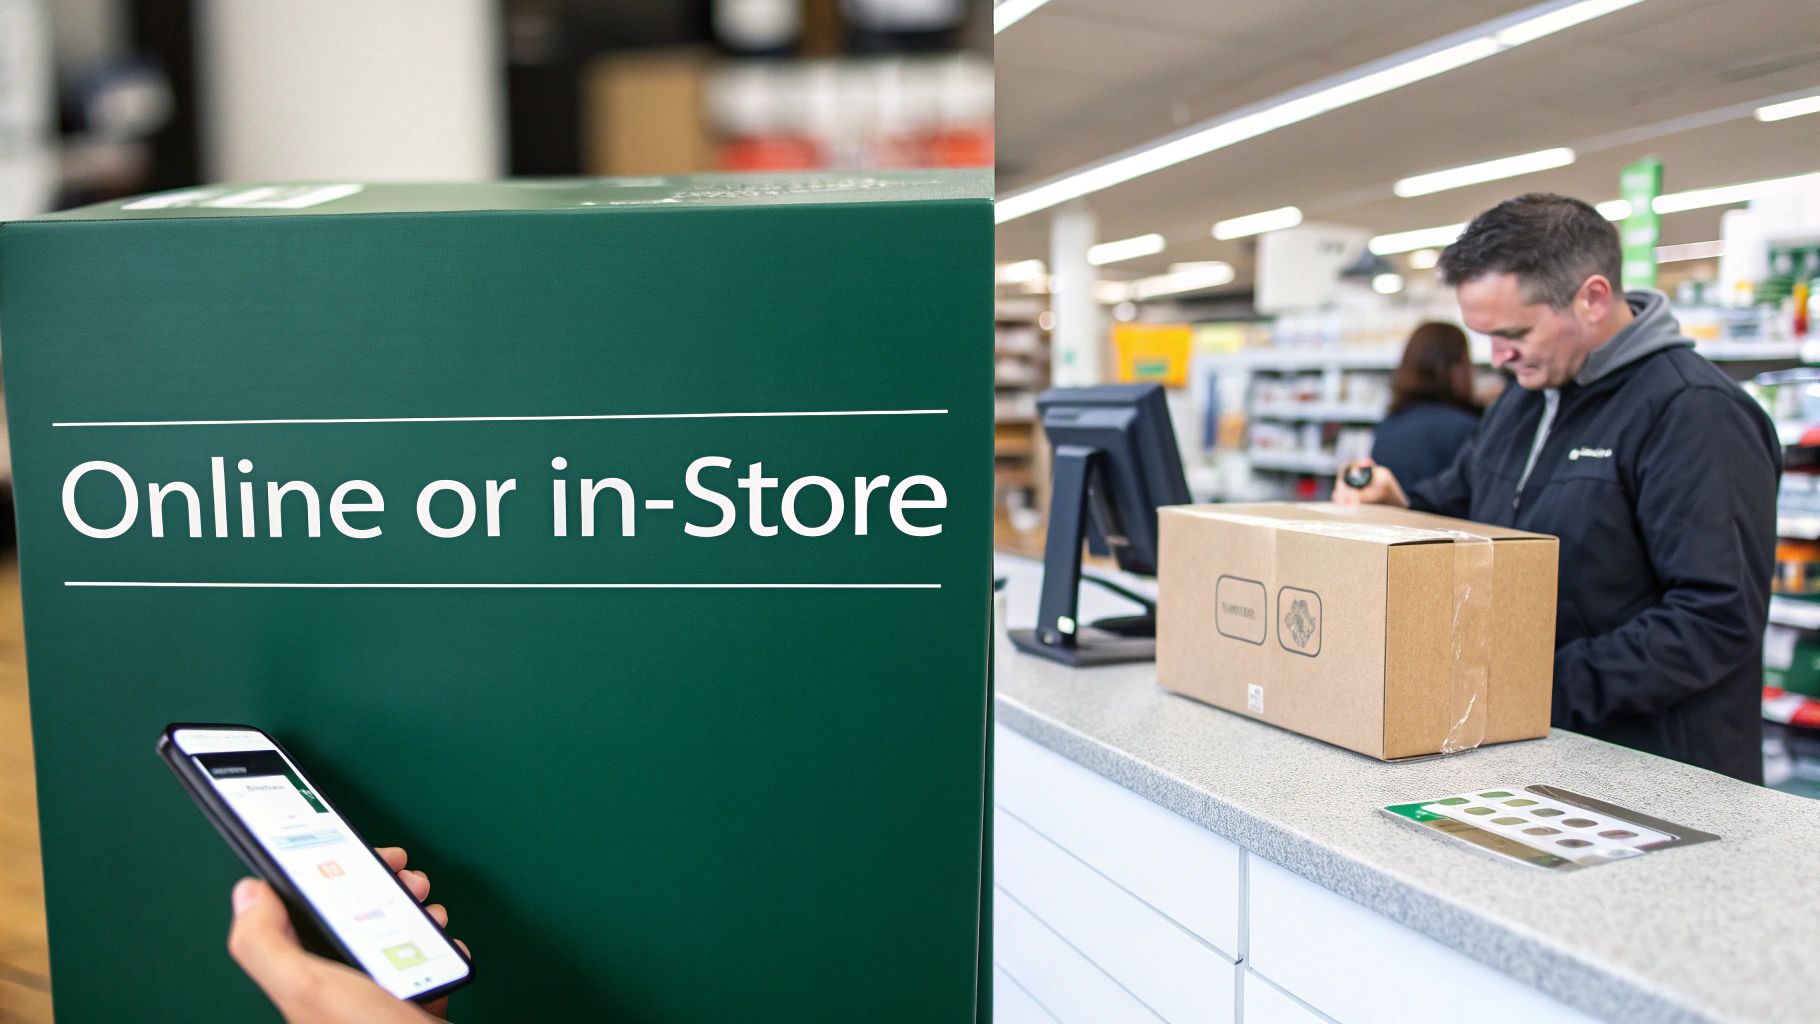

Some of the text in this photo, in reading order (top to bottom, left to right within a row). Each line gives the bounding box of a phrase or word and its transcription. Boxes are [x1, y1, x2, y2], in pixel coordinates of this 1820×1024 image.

[61, 456, 948, 539] Online or in-Store
